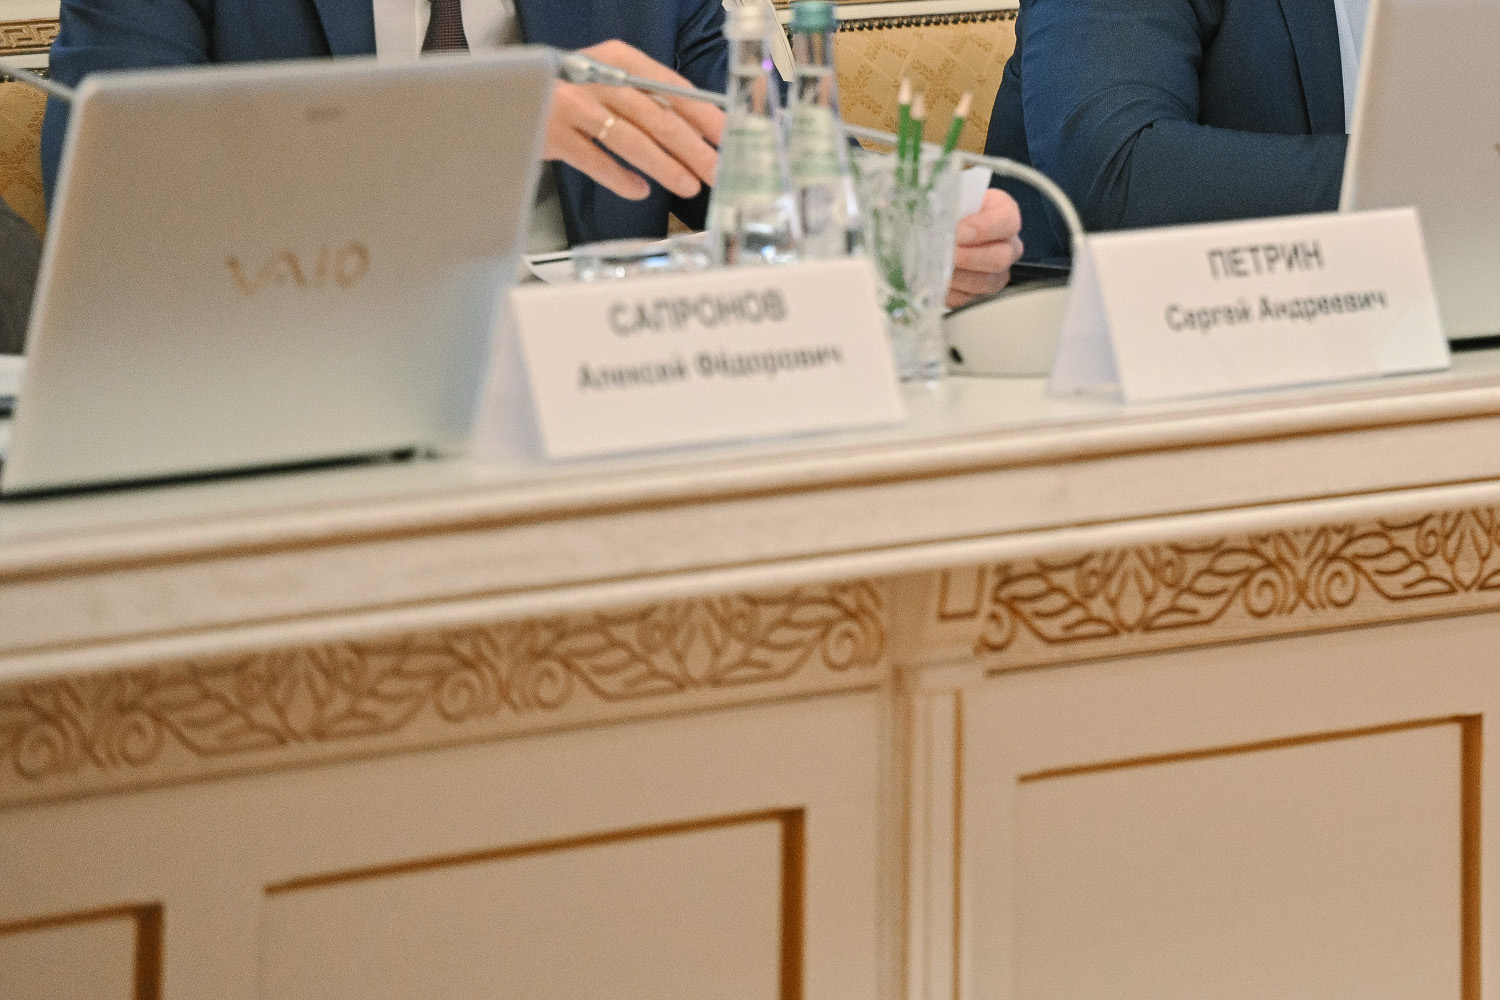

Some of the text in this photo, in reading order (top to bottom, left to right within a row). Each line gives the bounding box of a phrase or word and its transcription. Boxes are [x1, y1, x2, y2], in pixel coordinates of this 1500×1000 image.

[1207, 239, 1326, 279] ПЕТРИН
[607, 288, 788, 335] САПРОНОВ
[1165, 290, 1388, 333] Сергей Андреевич
